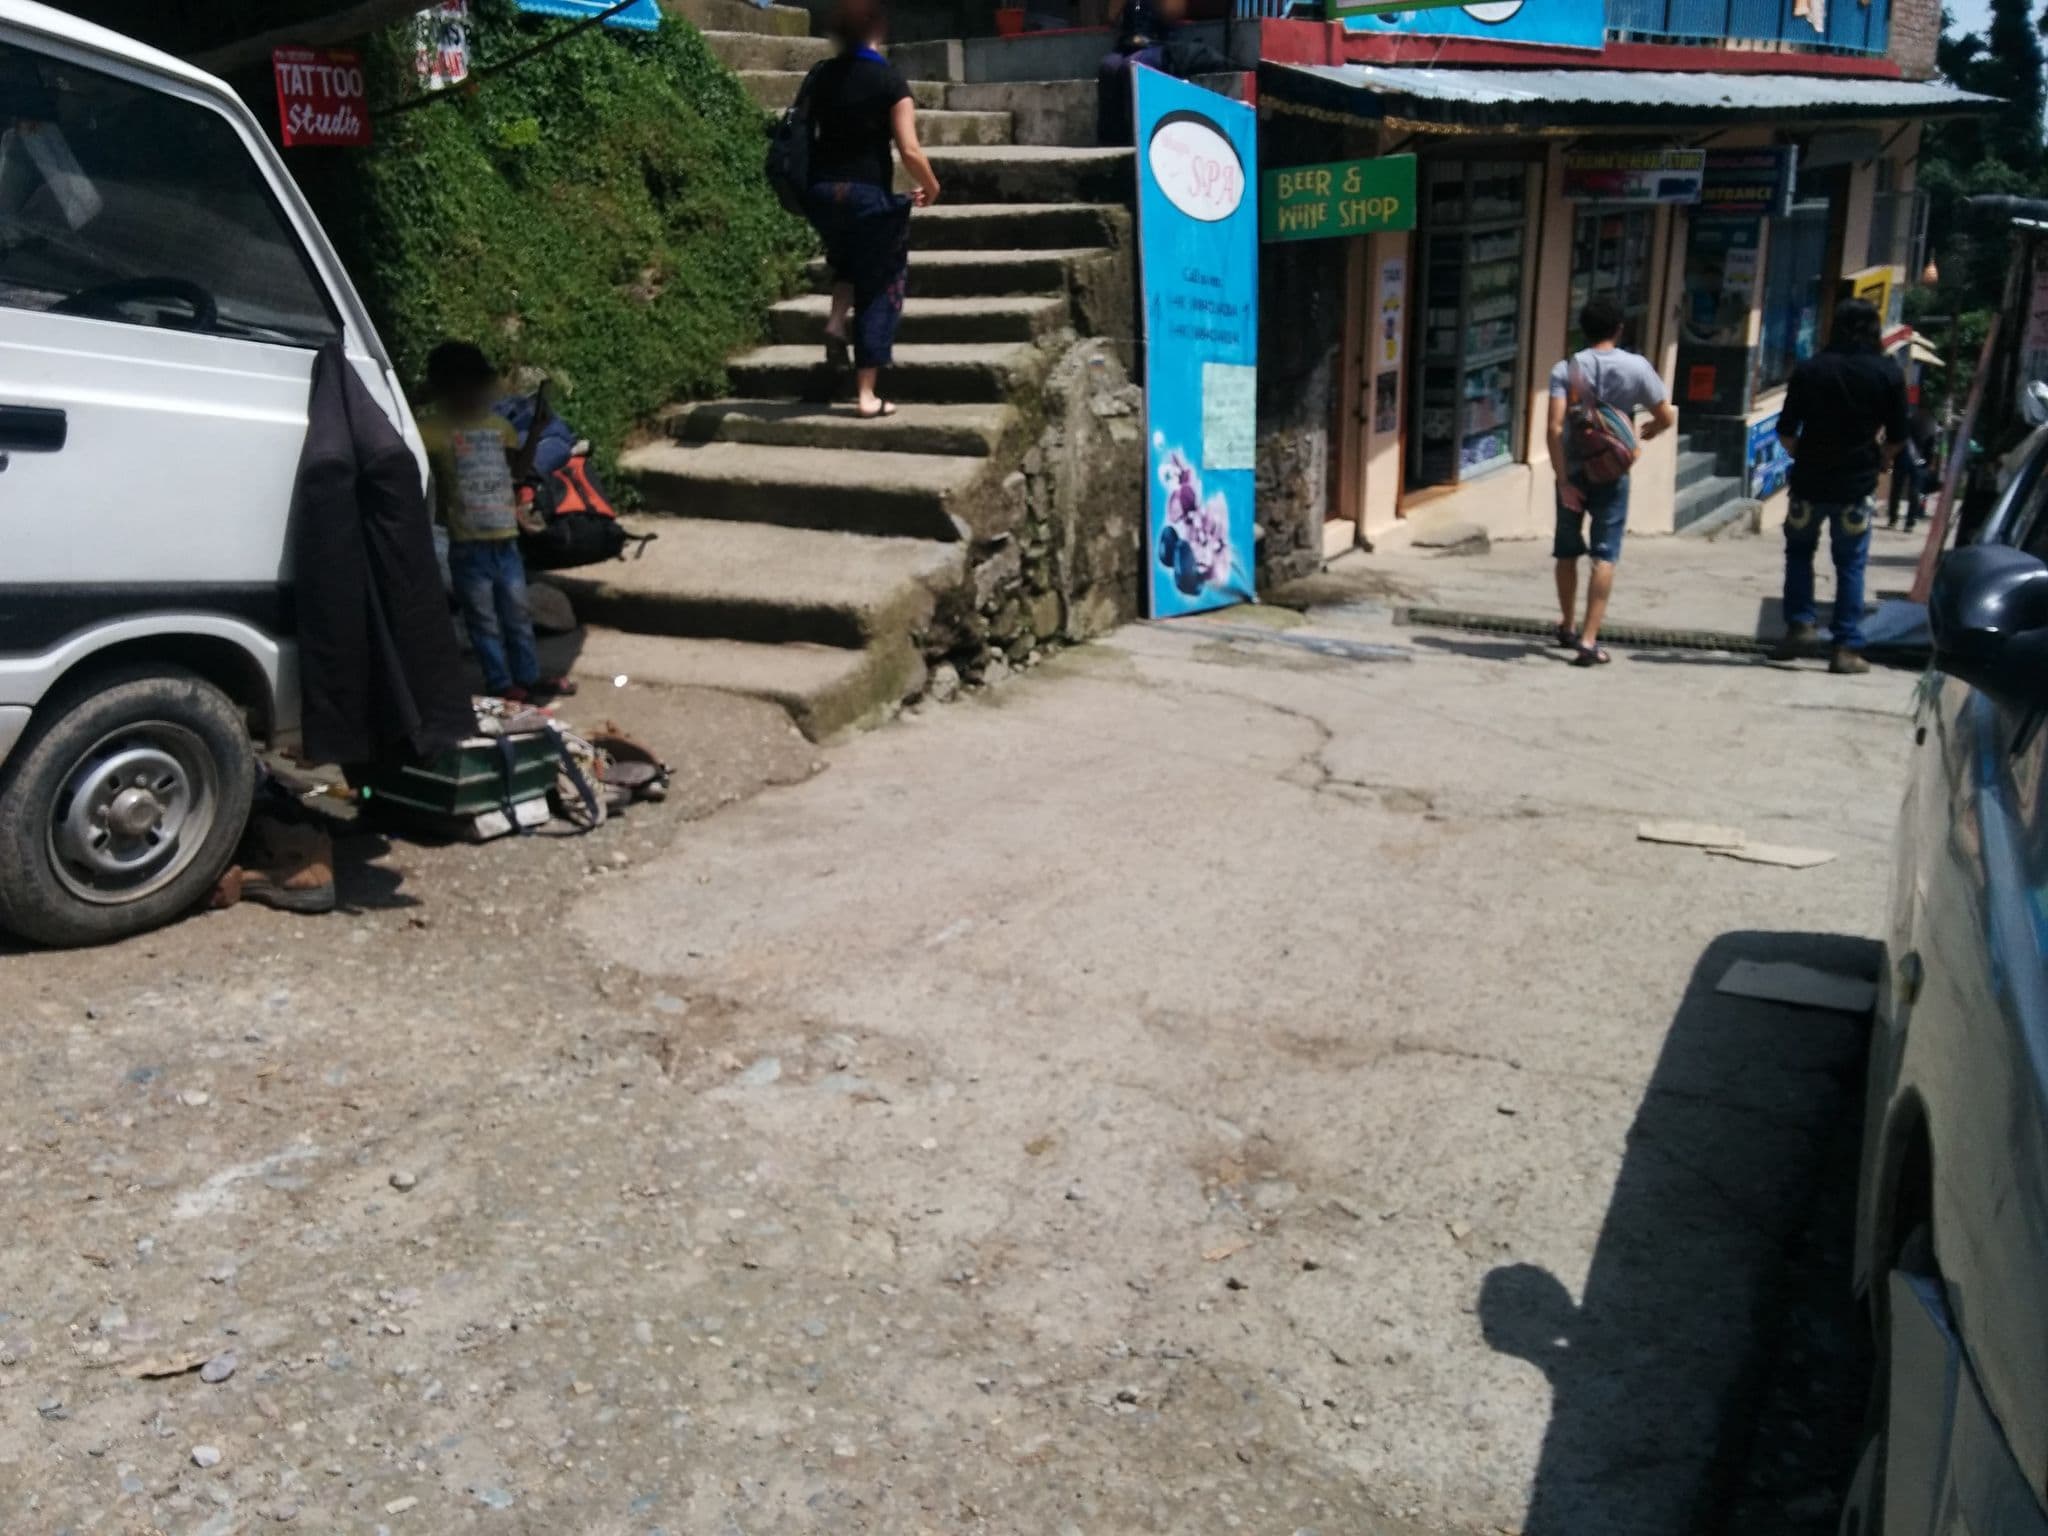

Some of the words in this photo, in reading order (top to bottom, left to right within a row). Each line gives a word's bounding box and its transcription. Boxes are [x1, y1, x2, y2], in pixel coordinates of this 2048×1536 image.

[275, 63, 363, 98] TATTOO
[286, 103, 361, 136] Studio
[1188, 156, 1236, 204] SPA
[1279, 169, 1330, 199] BEER
[1343, 166, 1361, 193] &
[1278, 203, 1328, 232] WINE
[1339, 197, 1399, 228] SHOP
